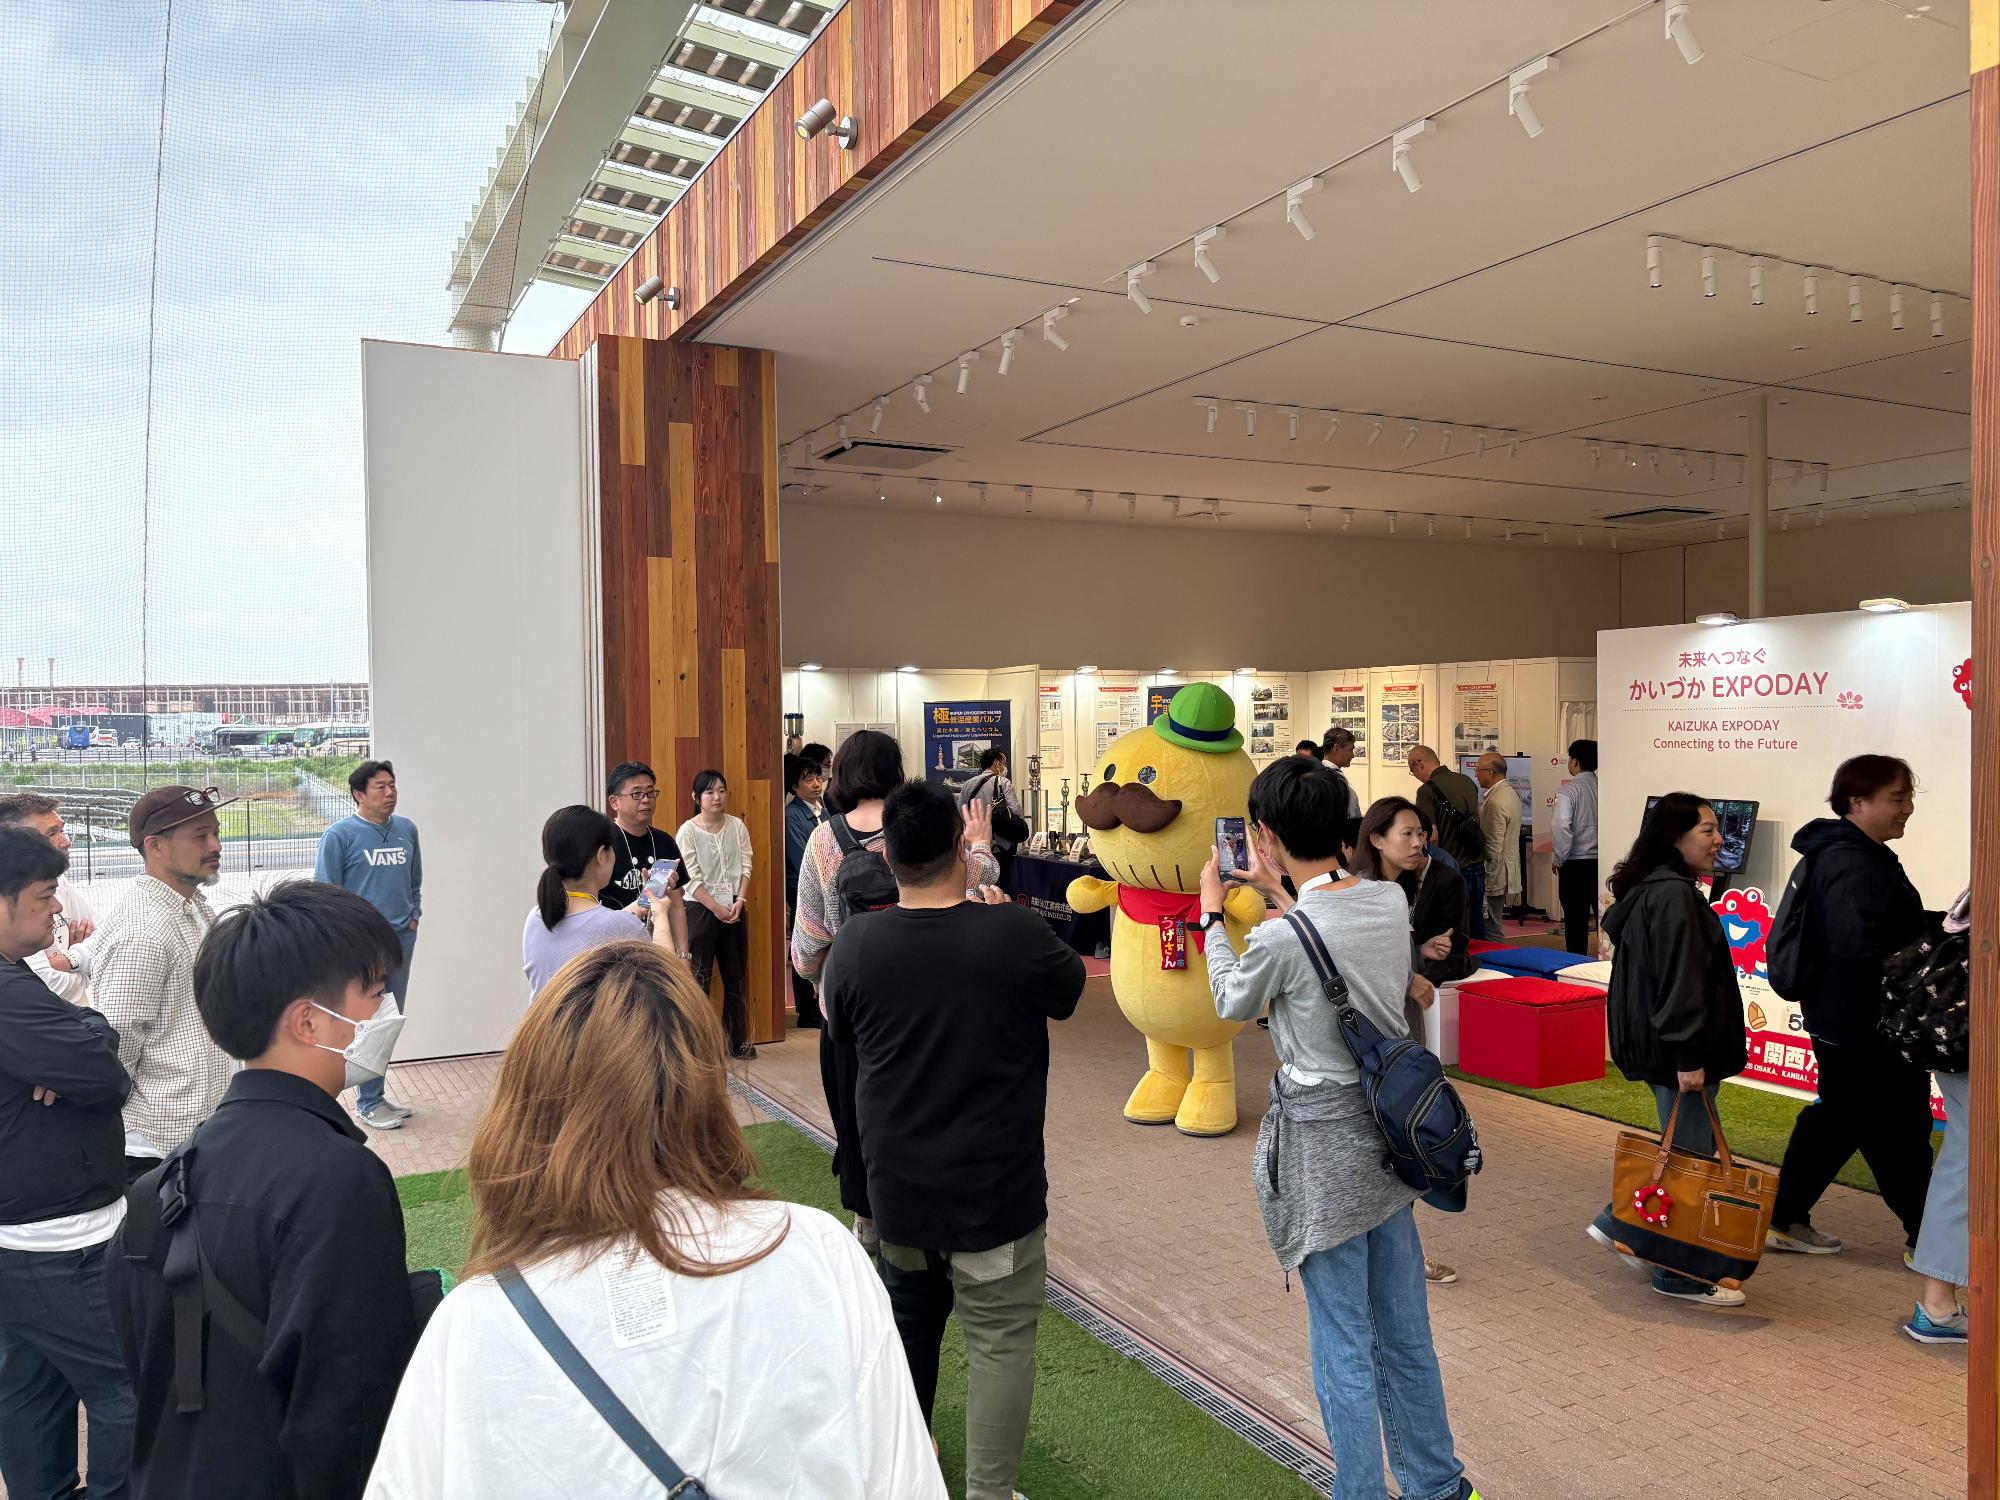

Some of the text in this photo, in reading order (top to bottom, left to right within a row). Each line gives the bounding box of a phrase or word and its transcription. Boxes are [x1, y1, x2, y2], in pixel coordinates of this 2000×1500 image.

[1678, 647, 1767, 668] 未来へつなぐ
[1629, 672, 1829, 701] かいづか EXPODAY
[1668, 719, 1780, 732] KAIZUKA EXPODAY
[1653, 738, 1798, 752] Connecting to the Future
[363, 847, 407, 866] VANS
